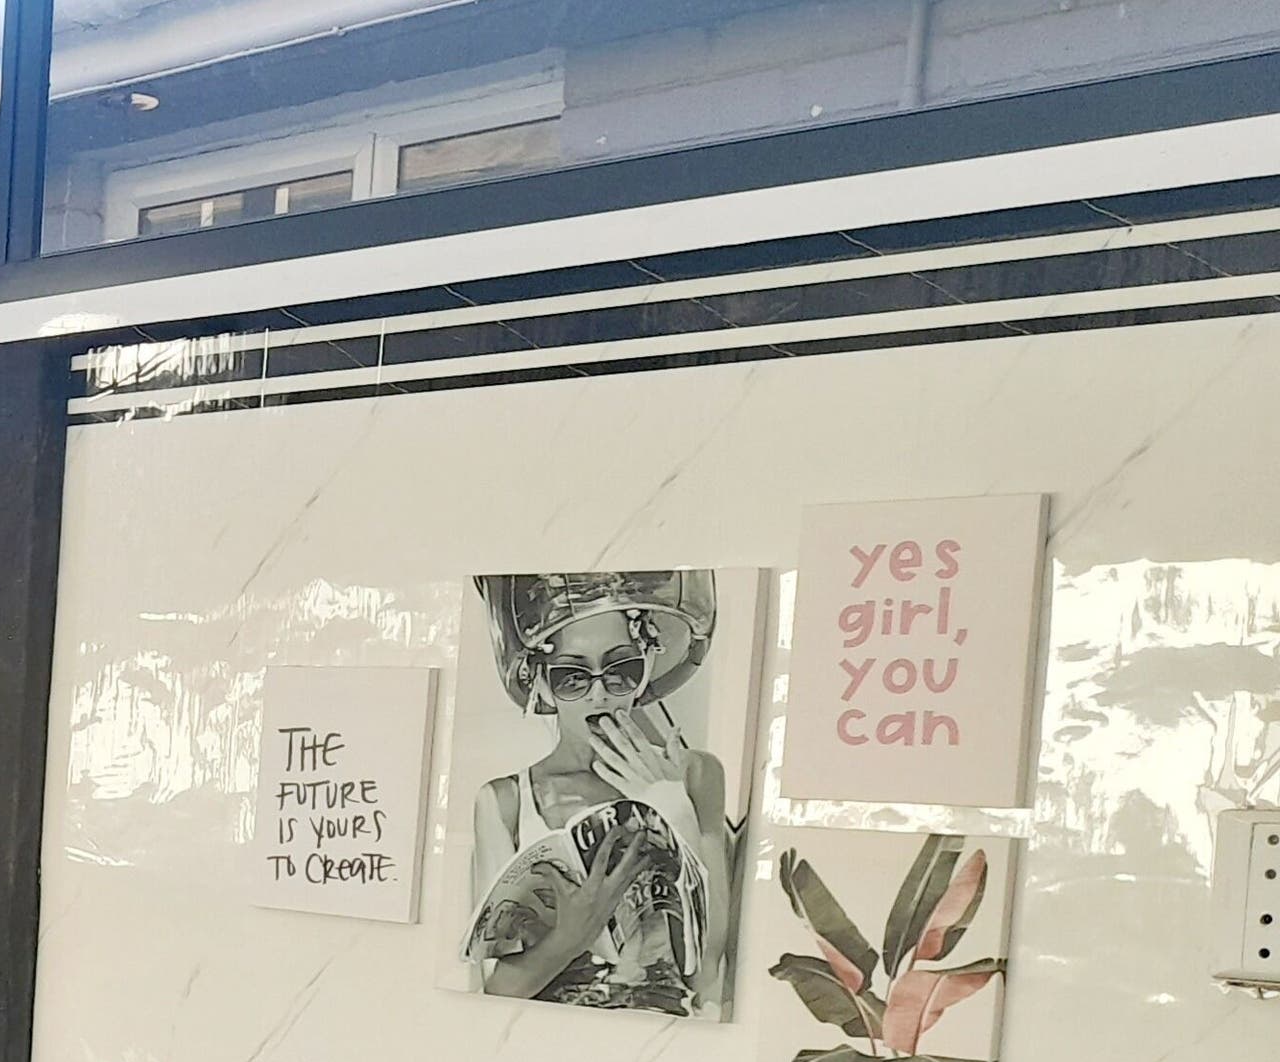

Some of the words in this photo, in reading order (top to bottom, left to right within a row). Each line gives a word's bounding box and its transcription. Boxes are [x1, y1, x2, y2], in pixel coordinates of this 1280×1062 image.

[848, 539, 961, 589] yes
[838, 586, 968, 648] girl,
[838, 657, 959, 702] you
[836, 708, 960, 746] can
[278, 727, 345, 771] THE
[275, 780, 378, 810] FUTURE
[278, 818, 298, 844] IS
[309, 810, 387, 848] YOURS
[267, 855, 296, 880] TO
